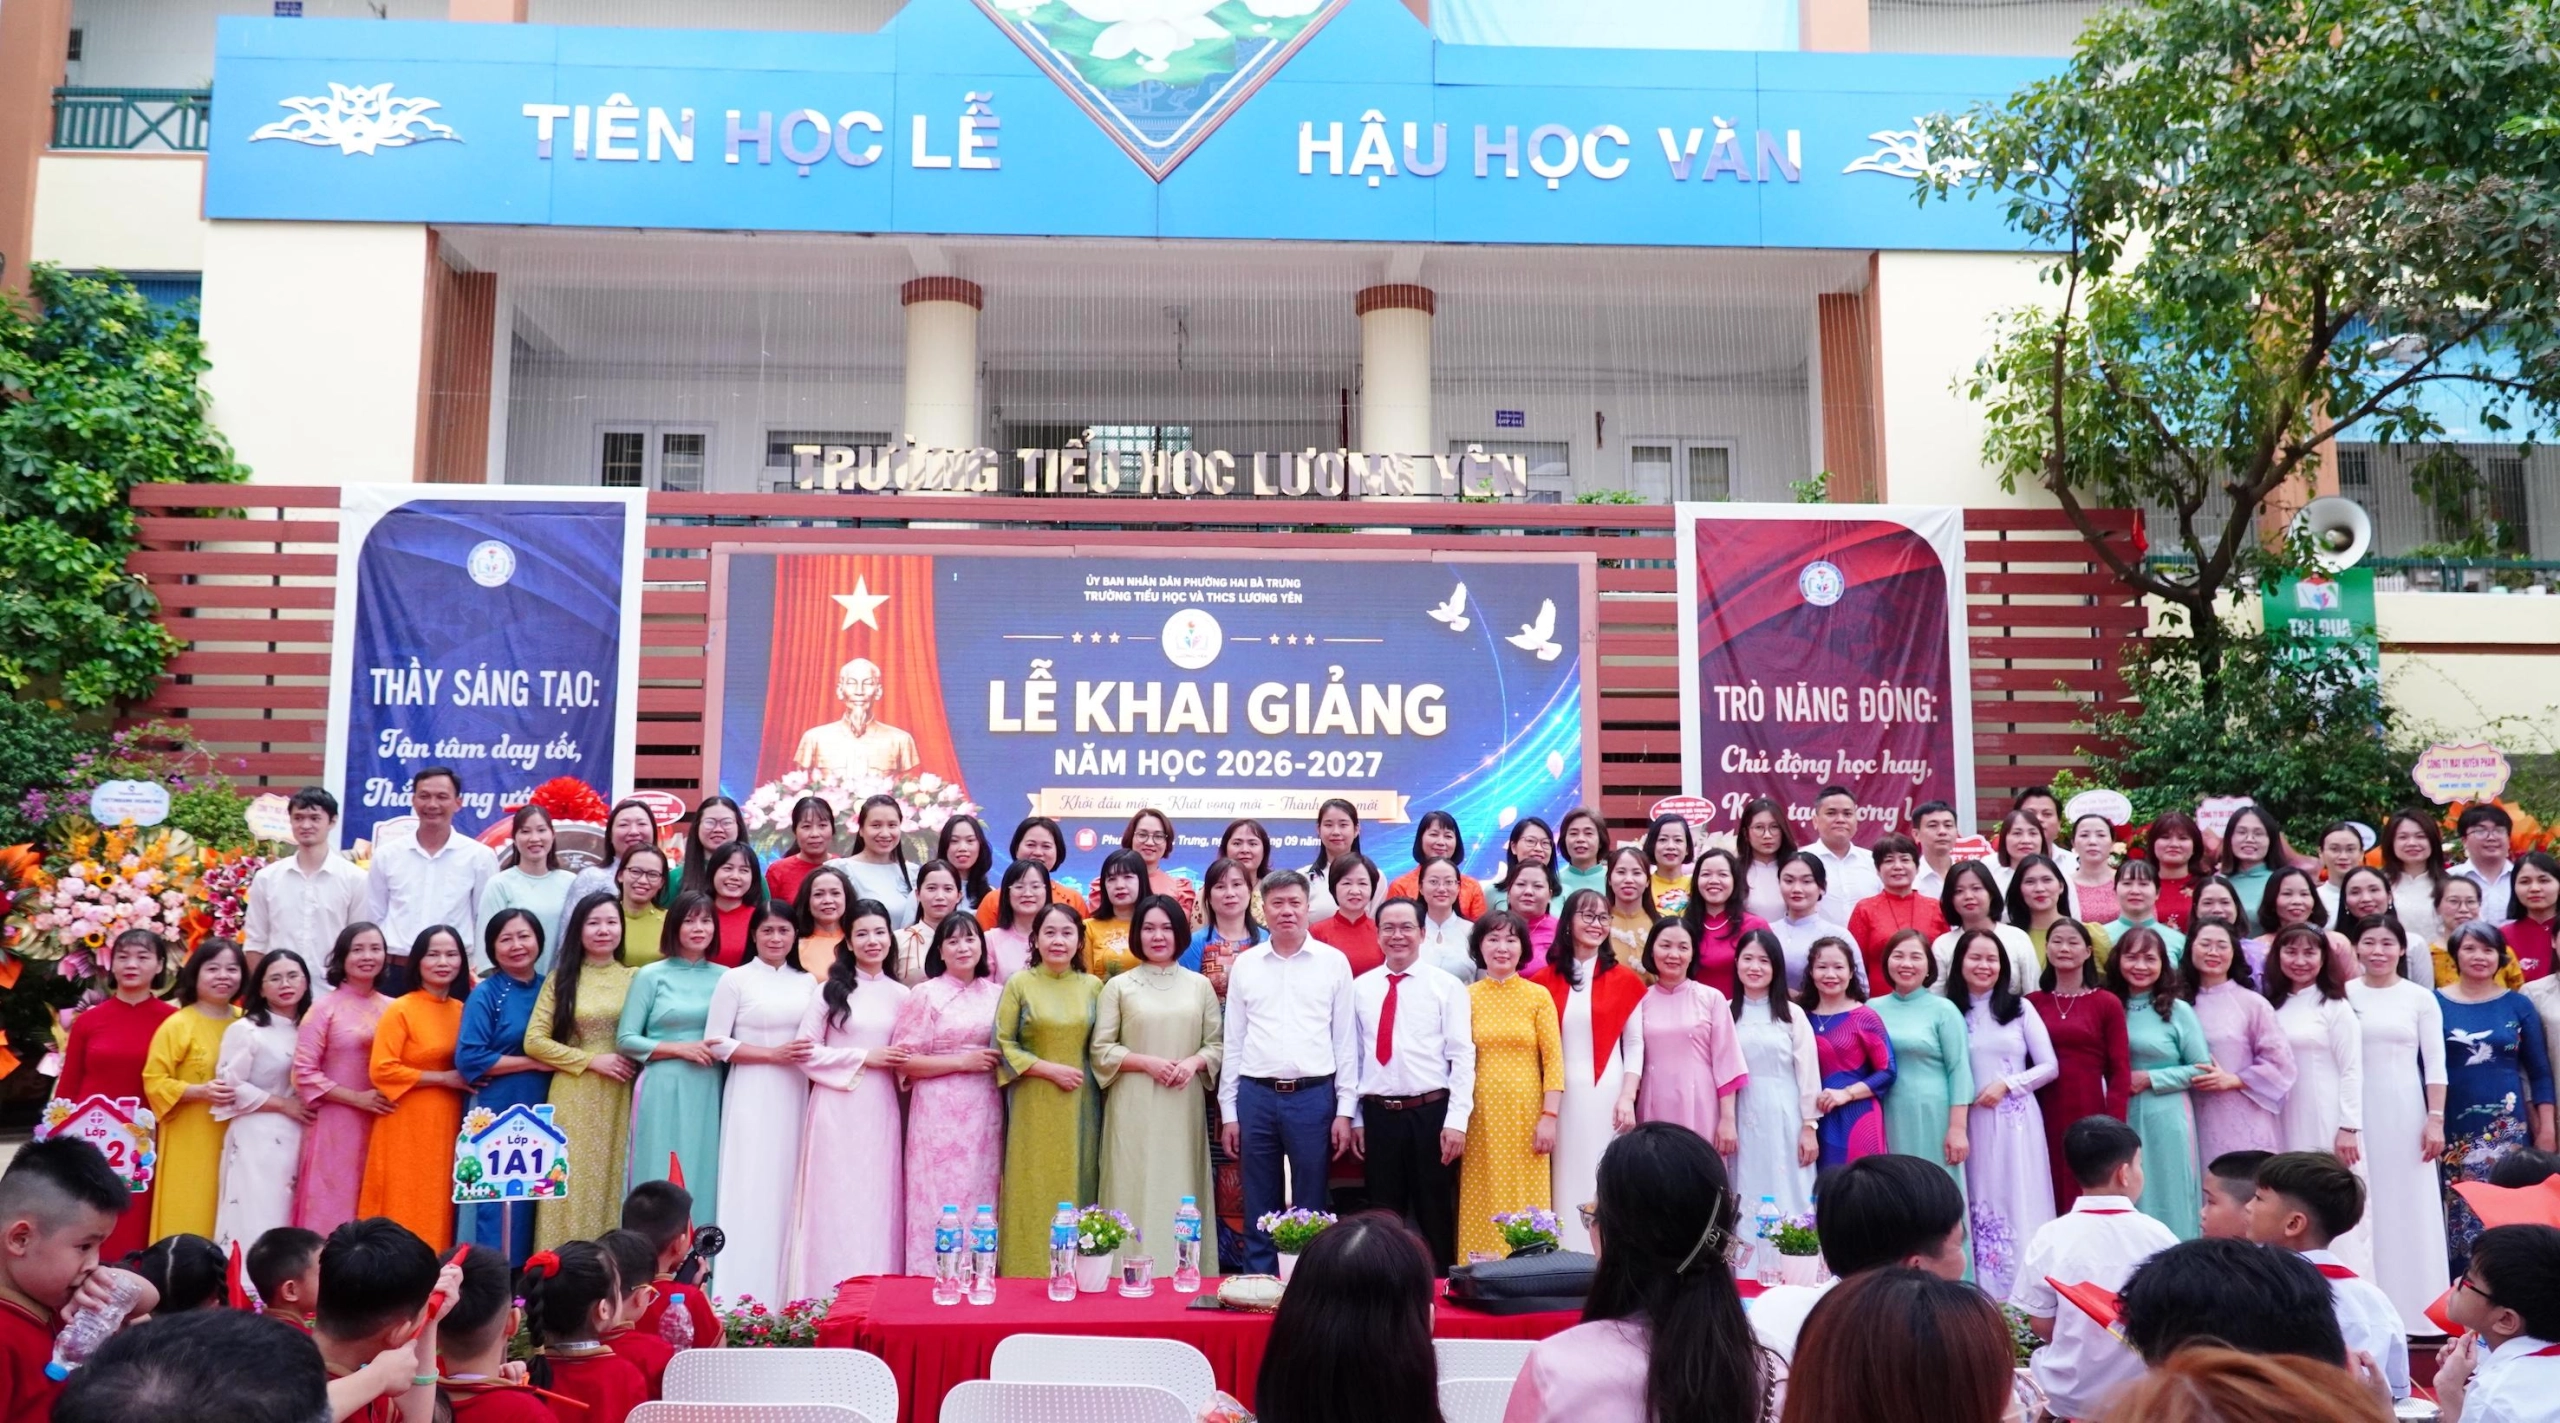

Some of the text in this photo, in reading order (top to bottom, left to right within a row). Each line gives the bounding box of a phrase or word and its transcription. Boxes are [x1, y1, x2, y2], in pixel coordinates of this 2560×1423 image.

[522, 90, 1000, 177] TIÊN HỌC LỄ
[1299, 109, 1802, 190] HẬU HỌC VĂN
[793, 434, 999, 491] TRƯỜNG
[1017, 429, 1120, 494] TIỂU
[1254, 447, 1414, 496] LƯƠNG
[1433, 443, 1527, 497] YÊN
[1084, 589, 1131, 602] TRƯỜNG
[1162, 592, 1186, 604] HỌC
[1189, 590, 1204, 602] VÀ
[1206, 592, 1236, 602] THCS
[1239, 592, 1278, 603] LƯƠNG
[1280, 591, 1303, 603] YÊN
[1103, 577, 1124, 586] BAN
[1127, 575, 1156, 586] NHÂN
[1159, 575, 1181, 587] DÂN
[1184, 576, 1227, 587] PHƯỜNG
[1230, 578, 1247, 588] HAI
[1250, 576, 1264, 588] BÀ
[1266, 578, 1301, 588] TRƯNG
[370, 656, 600, 714] THẦY SÁNG TẠO:
[989, 658, 1447, 737] LỄ KHAI GIẢNG
[1714, 679, 1938, 729] TRÒ NĂNG ĐỘNG:
[378, 728, 582, 771] Tận tâm dạy tốt,
[1055, 743, 1383, 783] NĂM HỌC 2026-2027
[1720, 744, 1933, 785] Chủ động học hay,
[363, 777, 414, 815] Thắ
[1060, 795, 1093, 811] Khởi
[1240, 798, 1262, 810] mới
[1356, 798, 1379, 811] mới
[1178, 834, 1209, 848] Trưng,
[1284, 836, 1298, 846] 09
[85, 1127, 107, 1139] Lớp
[507, 1134, 528, 1146] Lớp
[488, 1148, 543, 1175] 1A1
